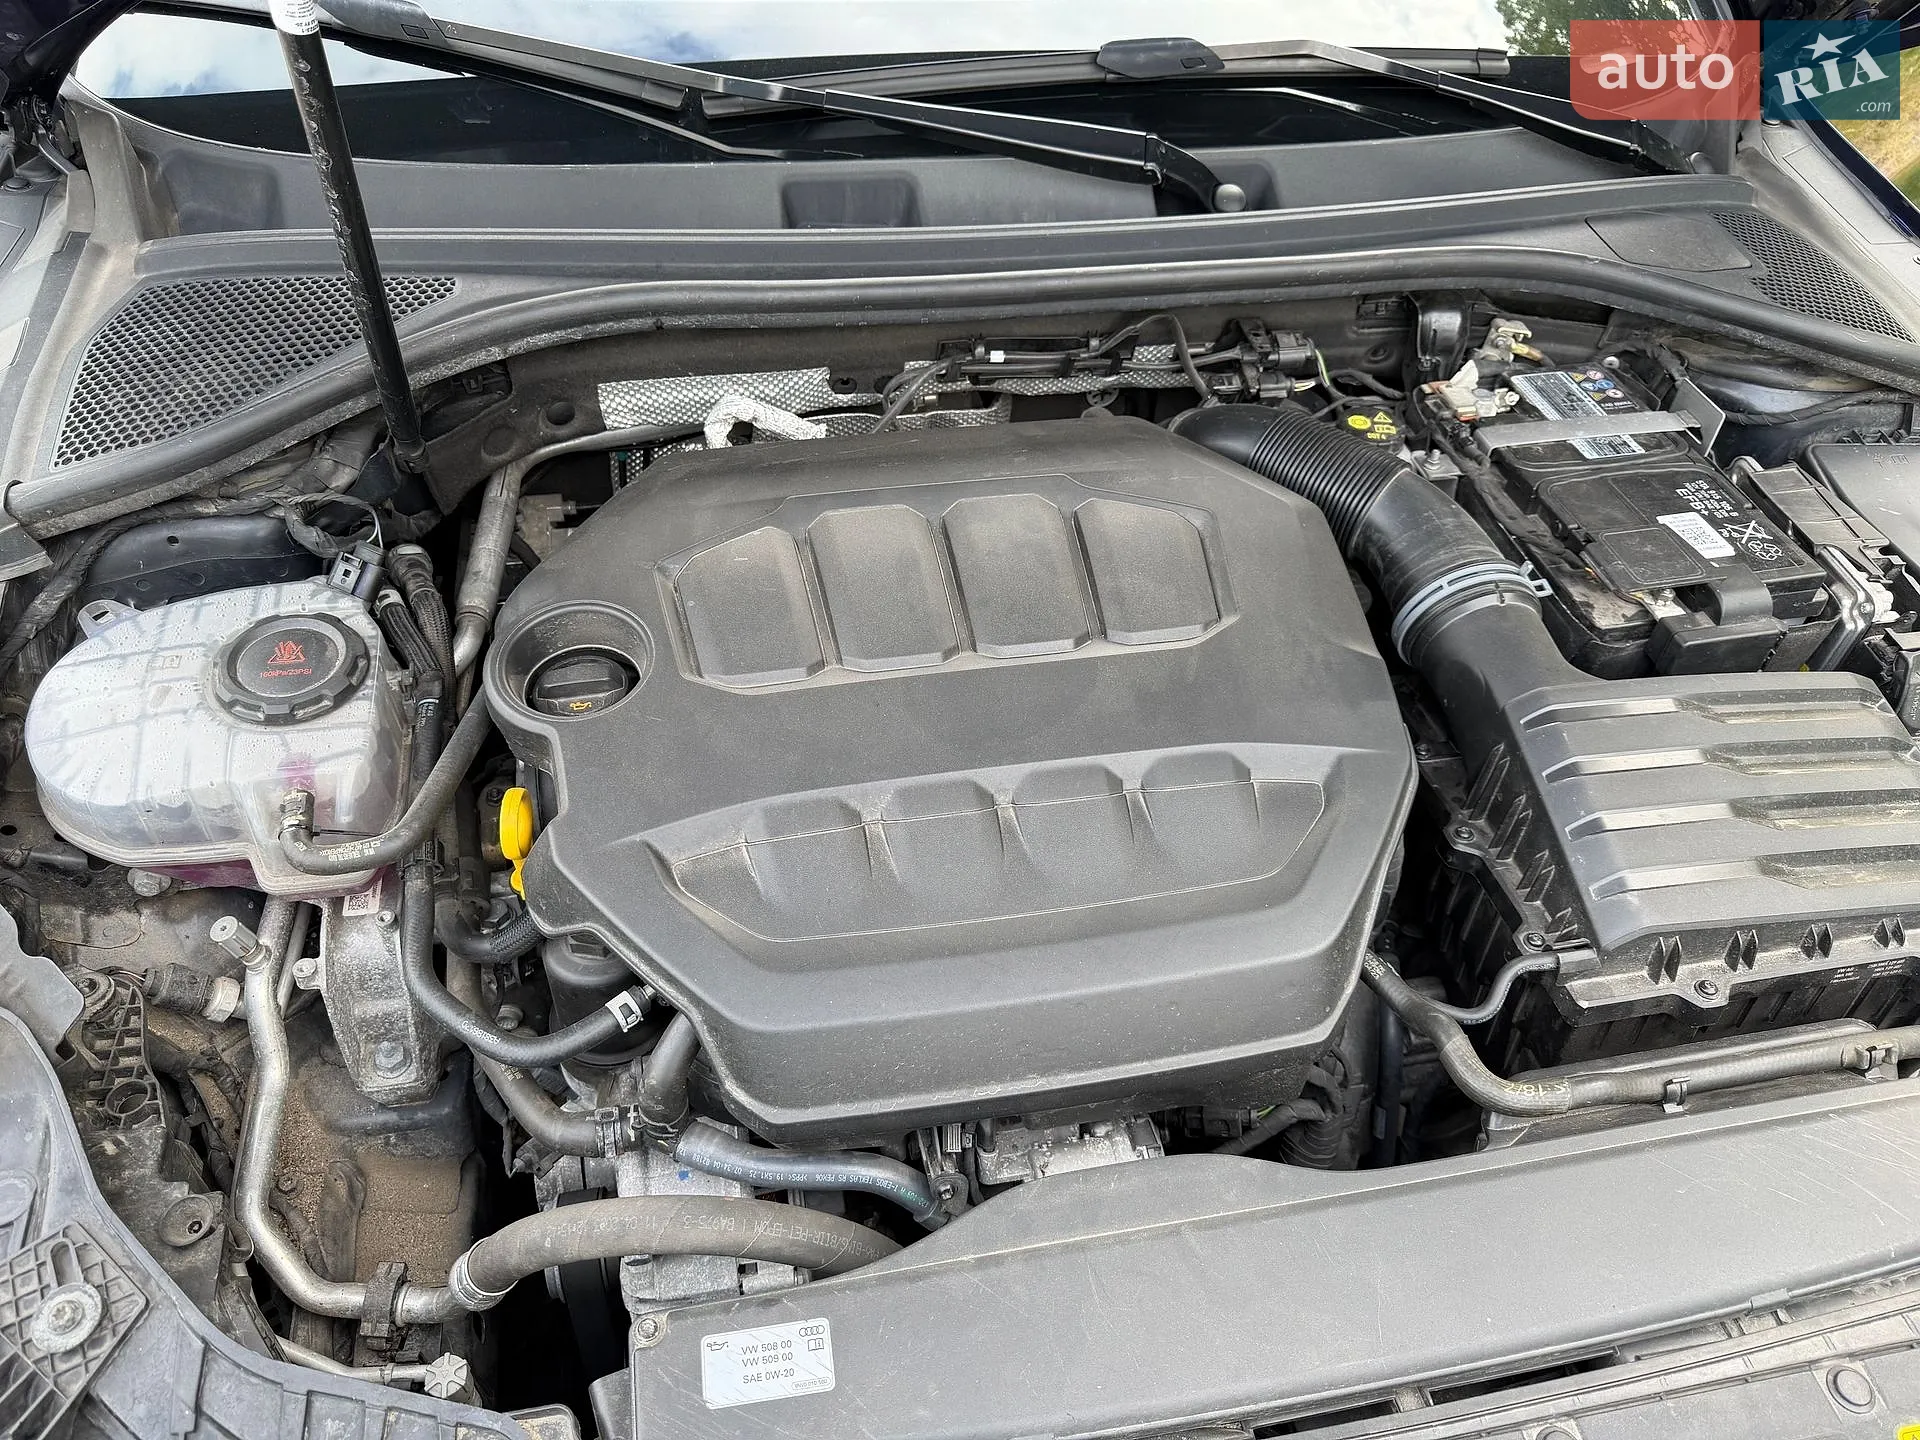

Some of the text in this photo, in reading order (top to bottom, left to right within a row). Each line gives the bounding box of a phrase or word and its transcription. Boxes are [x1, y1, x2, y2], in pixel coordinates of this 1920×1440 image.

[1675, 488, 1709, 516] EFB+
[741, 1339, 792, 1355] VW 508 00
[742, 1352, 793, 1367] VW 509 00
[743, 1368, 795, 1384] SAE 0W-20
